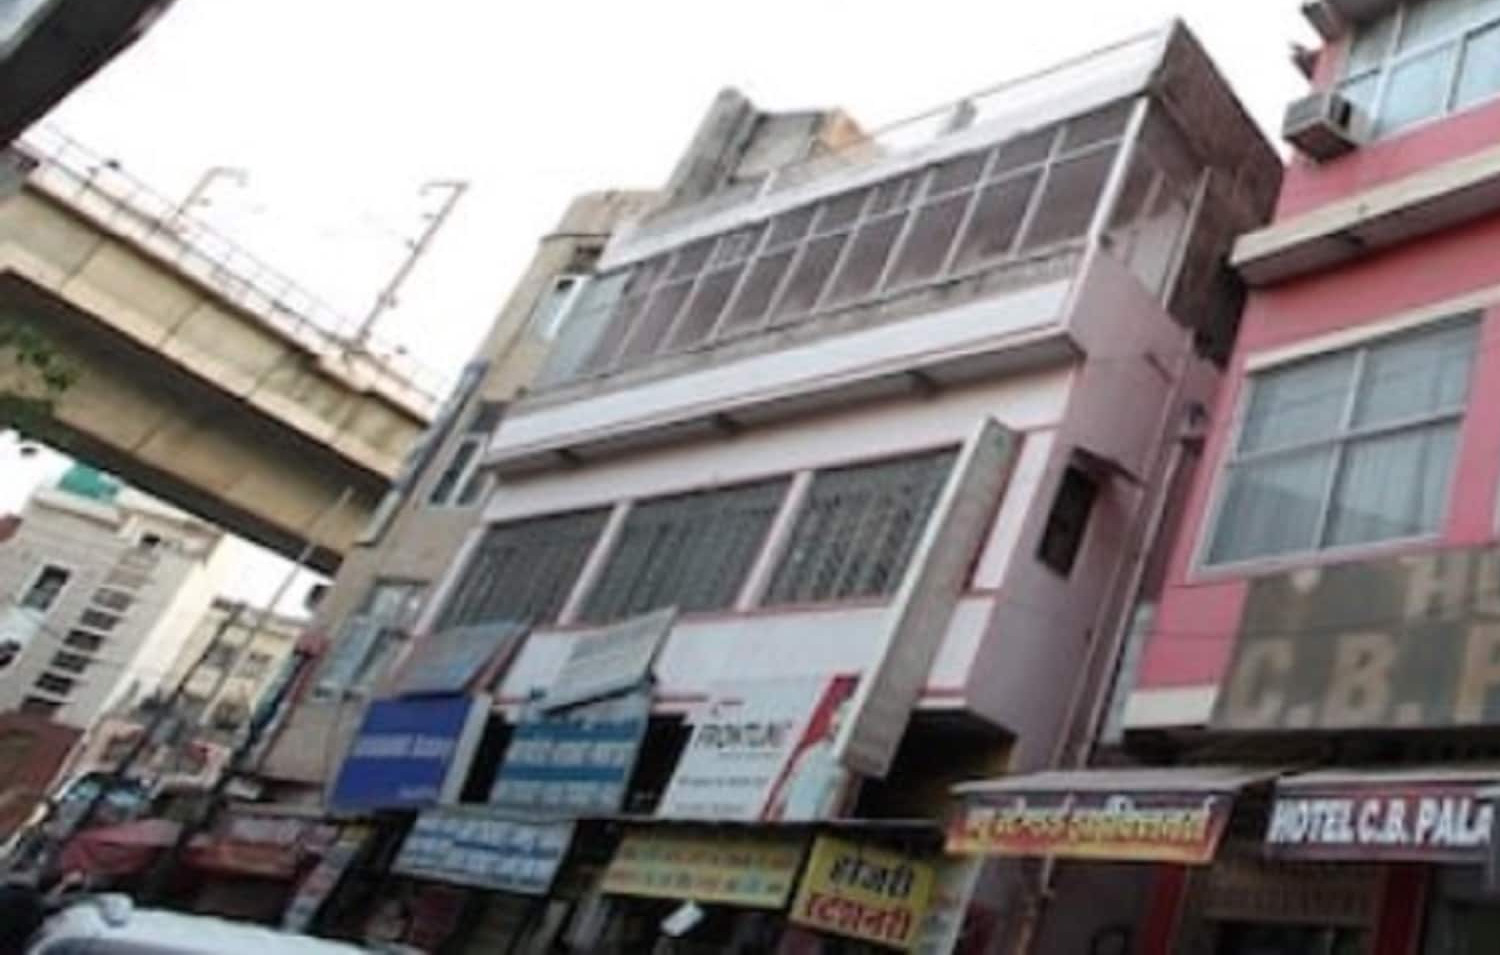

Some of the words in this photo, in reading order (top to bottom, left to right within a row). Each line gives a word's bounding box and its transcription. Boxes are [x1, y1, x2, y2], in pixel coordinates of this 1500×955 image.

[1224, 628, 1425, 727] C.B.
[1267, 797, 1356, 843] HOTEL
[1357, 799, 1408, 843] C.B.
[1415, 798, 1495, 845] PALA
